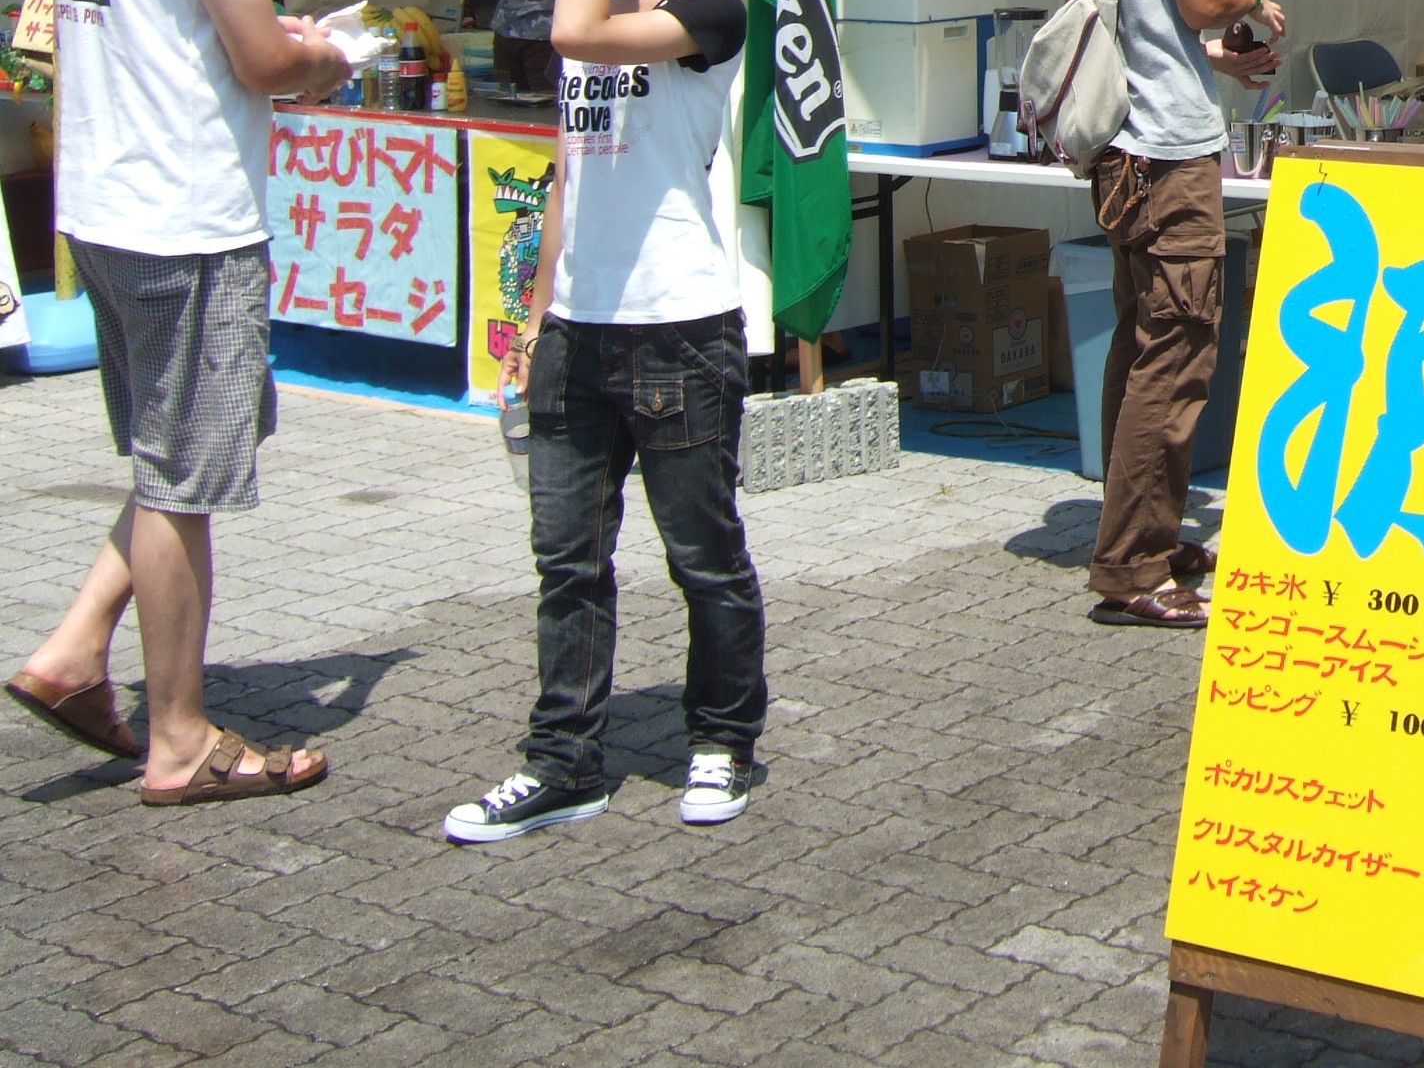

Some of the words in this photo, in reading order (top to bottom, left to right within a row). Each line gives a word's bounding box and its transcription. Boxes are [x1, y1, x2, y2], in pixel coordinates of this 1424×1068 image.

[268, 119, 457, 195] わさびトマト
[289, 193, 423, 261] サラダ
[1225, 567, 1307, 602] カキ氷
[1368, 588, 1420, 616] 300
[1217, 643, 1398, 687] マンゴーアイス
[1210, 679, 1322, 718] トッピング
[1204, 760, 1385, 814] ポカリスウェット
[1193, 817, 1421, 879] クリスタルカイザー
[1188, 870, 1319, 913] ハイネケン
